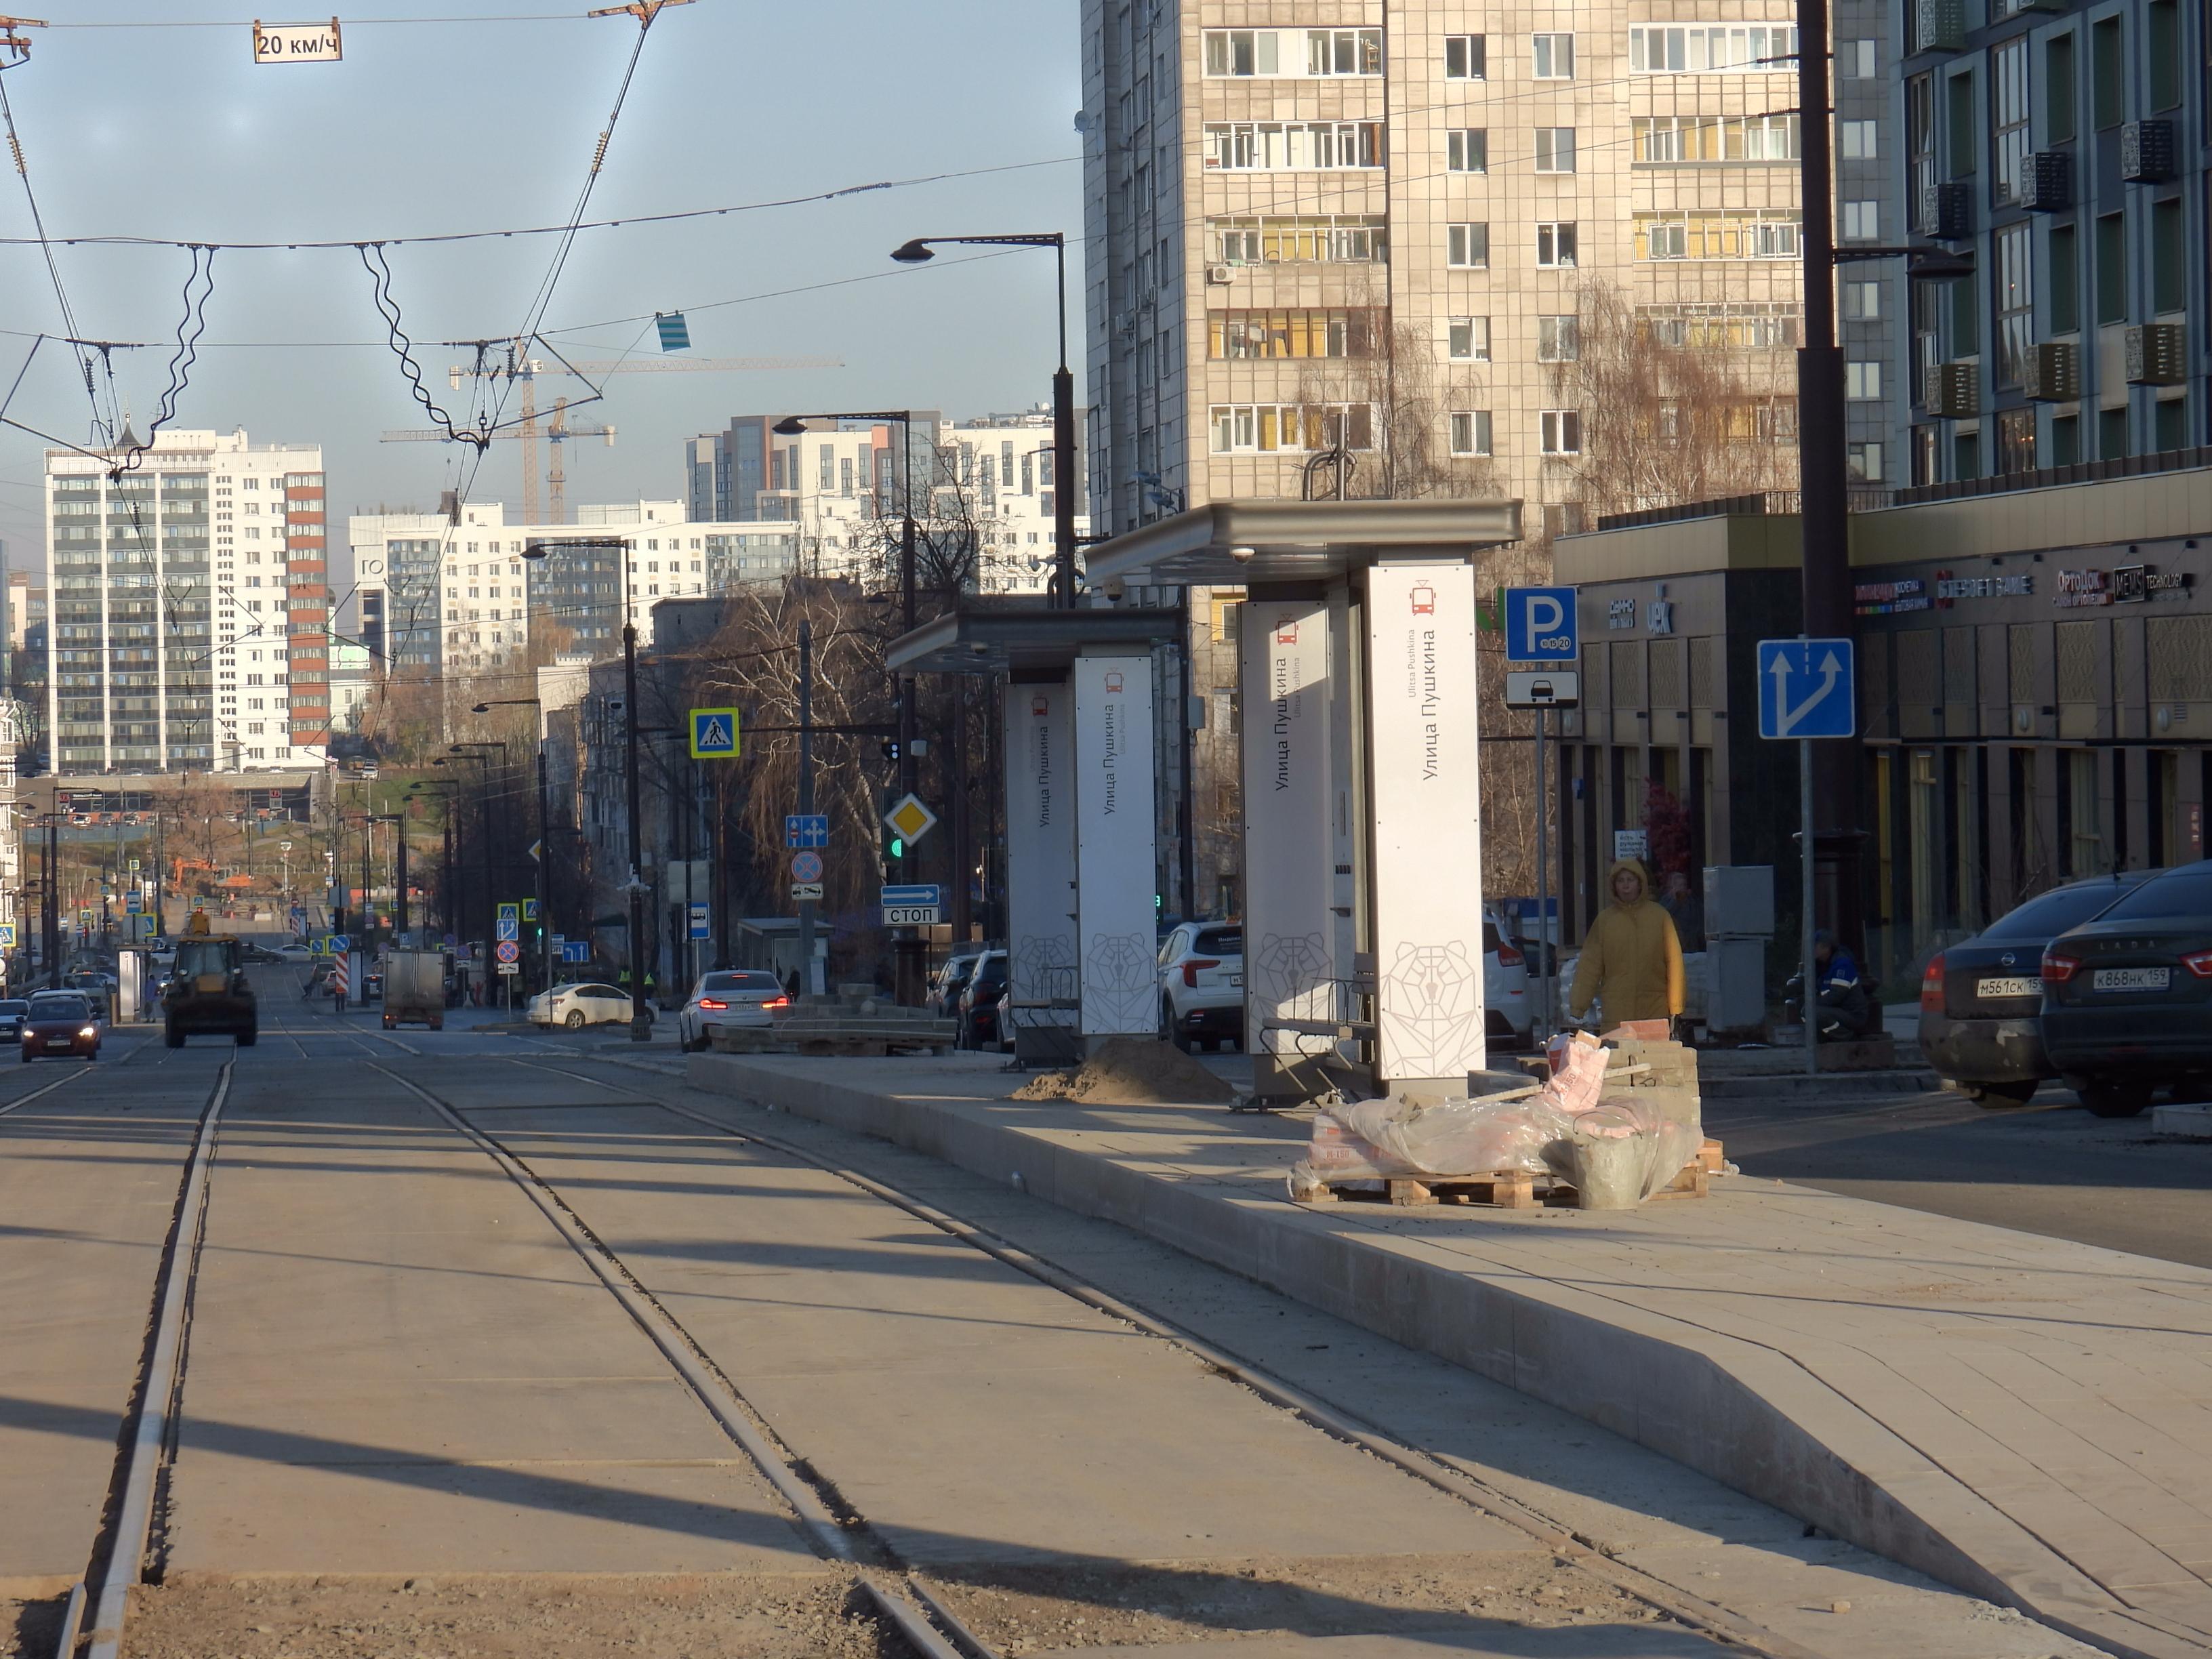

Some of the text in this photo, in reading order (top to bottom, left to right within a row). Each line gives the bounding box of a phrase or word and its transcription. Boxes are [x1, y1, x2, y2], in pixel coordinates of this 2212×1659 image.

[258, 34, 337, 54] 20 км/ч
[2146, 573, 2183, 589] TECHNOLOGY
[1559, 639, 1570, 648] 20
[1408, 630, 1416, 697] Ulitsa Pushkina
[1422, 630, 1441, 780] Улица Пушкина
[1275, 657, 1292, 792] Улица Пушкина
[1103, 704, 1118, 815] Улица Пушкина
[1038, 726, 1052, 827] Улица Пушкина
[890, 909, 932, 922] СТОП
[2100, 940, 2155, 950] LADA
[1980, 981, 2024, 994] М561СК
[2097, 969, 2166, 987] К868НК 159
